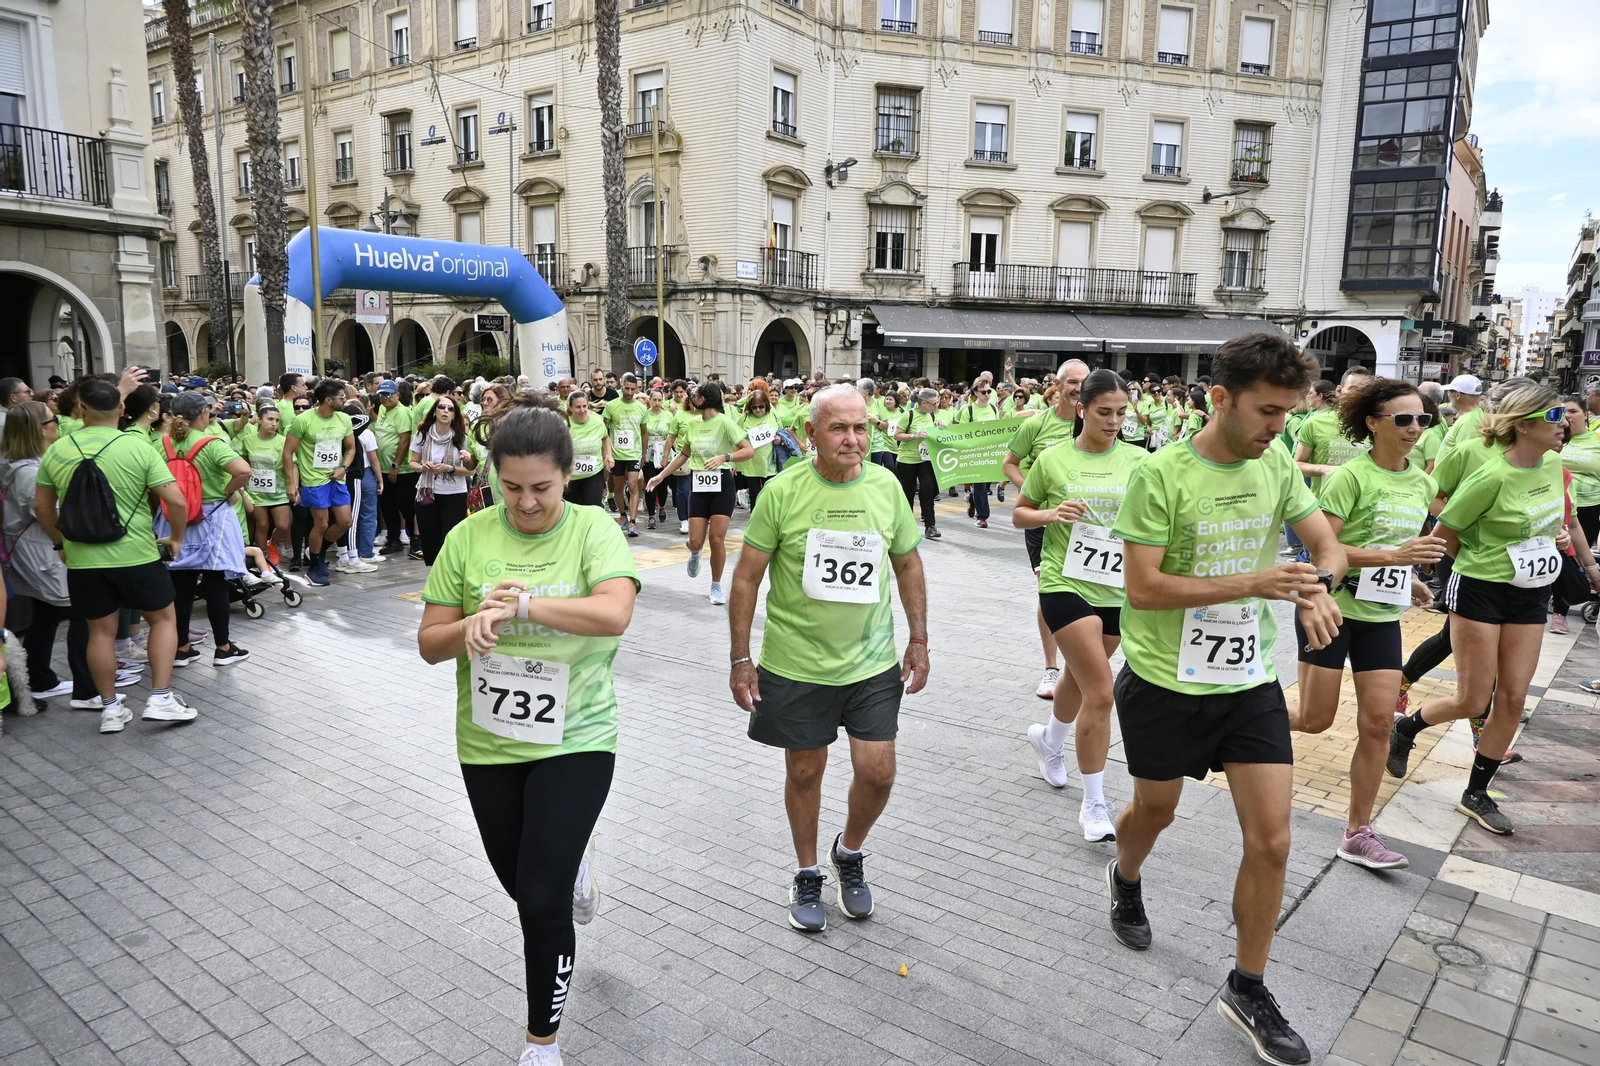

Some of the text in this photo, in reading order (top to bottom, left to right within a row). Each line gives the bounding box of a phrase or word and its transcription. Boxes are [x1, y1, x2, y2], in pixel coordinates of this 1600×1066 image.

[354, 242, 509, 281] Huelva original
[964, 339, 992, 348] RESTAURANTE
[936, 433, 963, 443] Contra
[964, 431, 973, 440] el
[974, 426, 1006, 438] Cáncer
[618, 437, 629, 445] 80
[959, 452, 982, 460] contra
[575, 462, 594, 473] 908
[968, 458, 998, 467] Calañas
[1067, 483, 1083, 493] En
[1377, 501, 1393, 512] En
[1197, 521, 1219, 536] En
[1195, 535, 1257, 556] contra
[509, 580, 580, 598] archa
[549, 954, 573, 1024] NIKE
